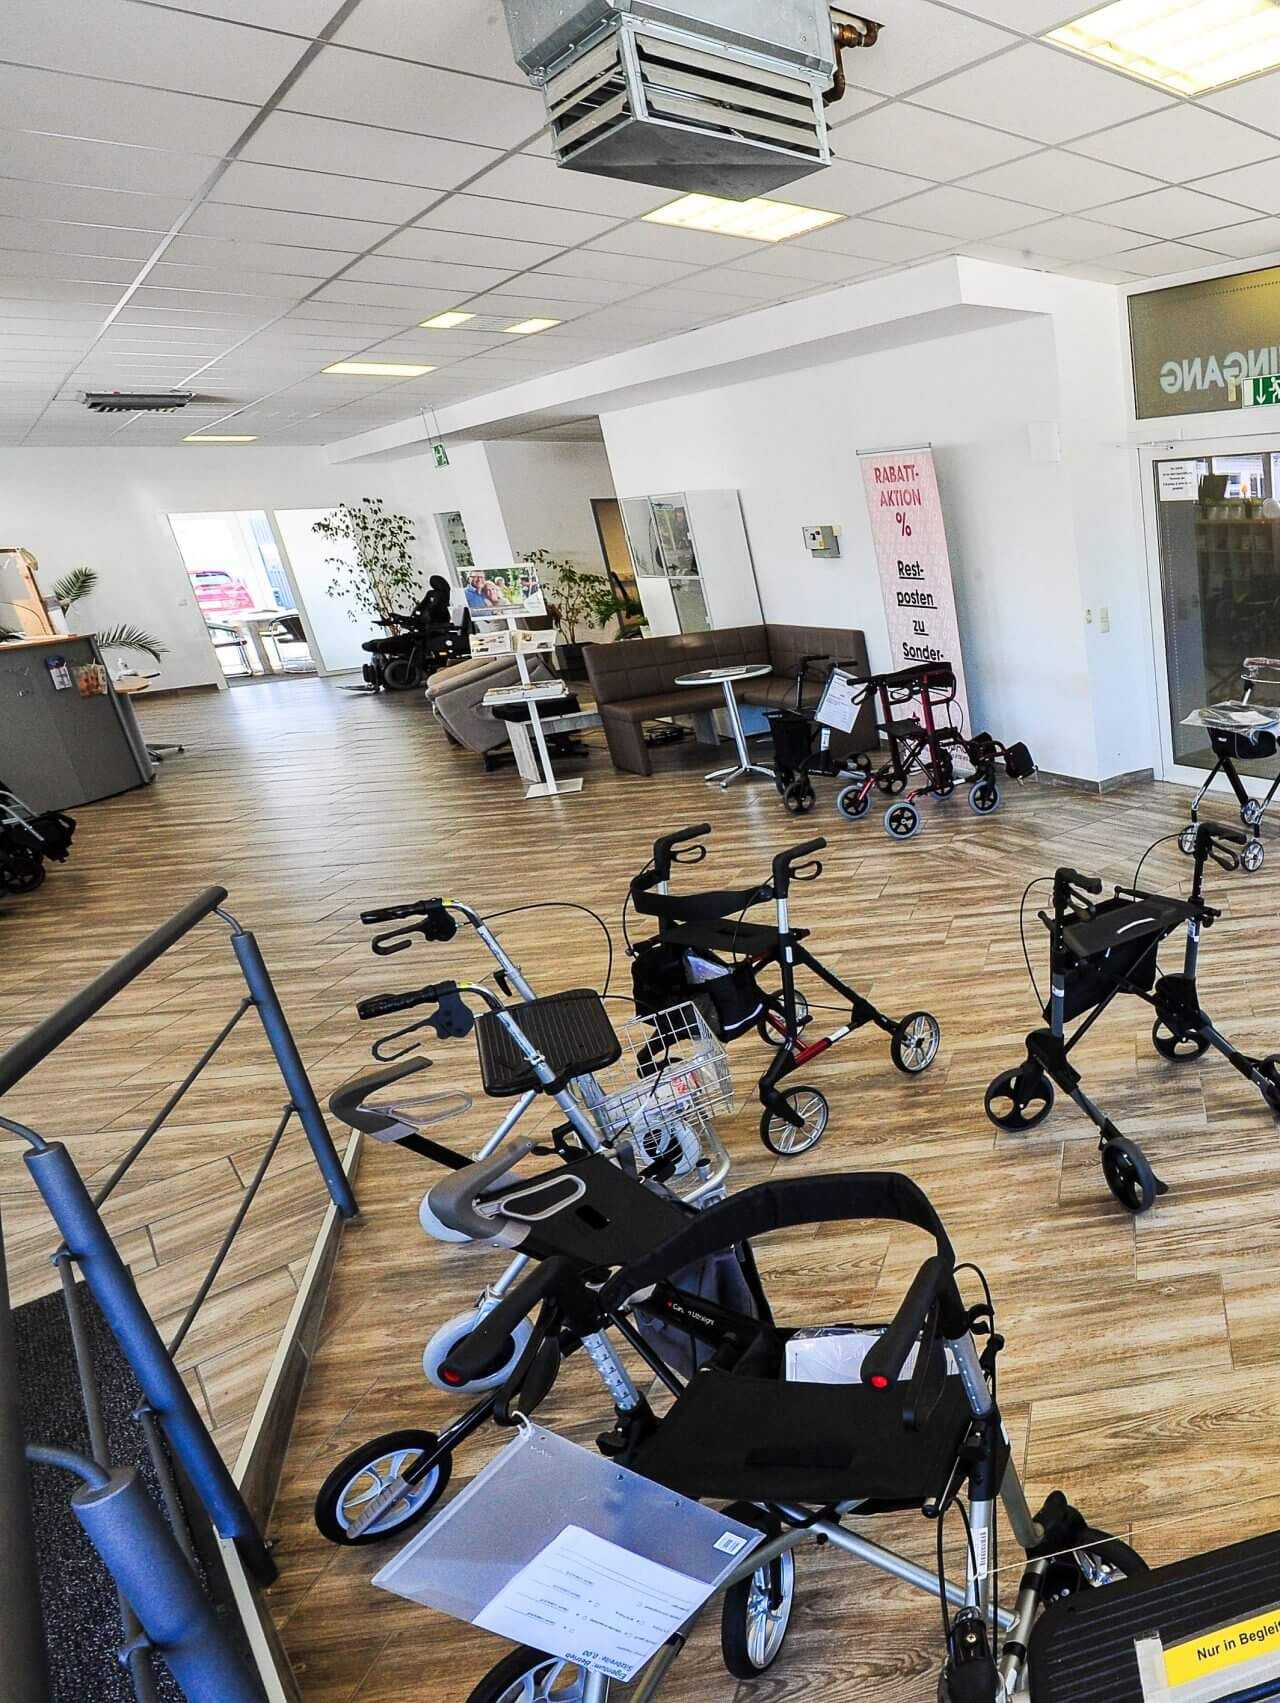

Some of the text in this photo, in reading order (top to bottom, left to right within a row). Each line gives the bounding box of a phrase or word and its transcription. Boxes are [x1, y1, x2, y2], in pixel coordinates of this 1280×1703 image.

[874, 464, 919, 484] RABATT-
[880, 488, 921, 507] AKTION
[895, 511, 912, 537] %
[896, 560, 924, 577] Rest-
[896, 590, 934, 607] posten
[912, 620, 925, 633] zu
[902, 642, 944, 662] Sonder-
[1197, 1643, 1220, 1661] Nur
[1222, 1638, 1237, 1652] in
